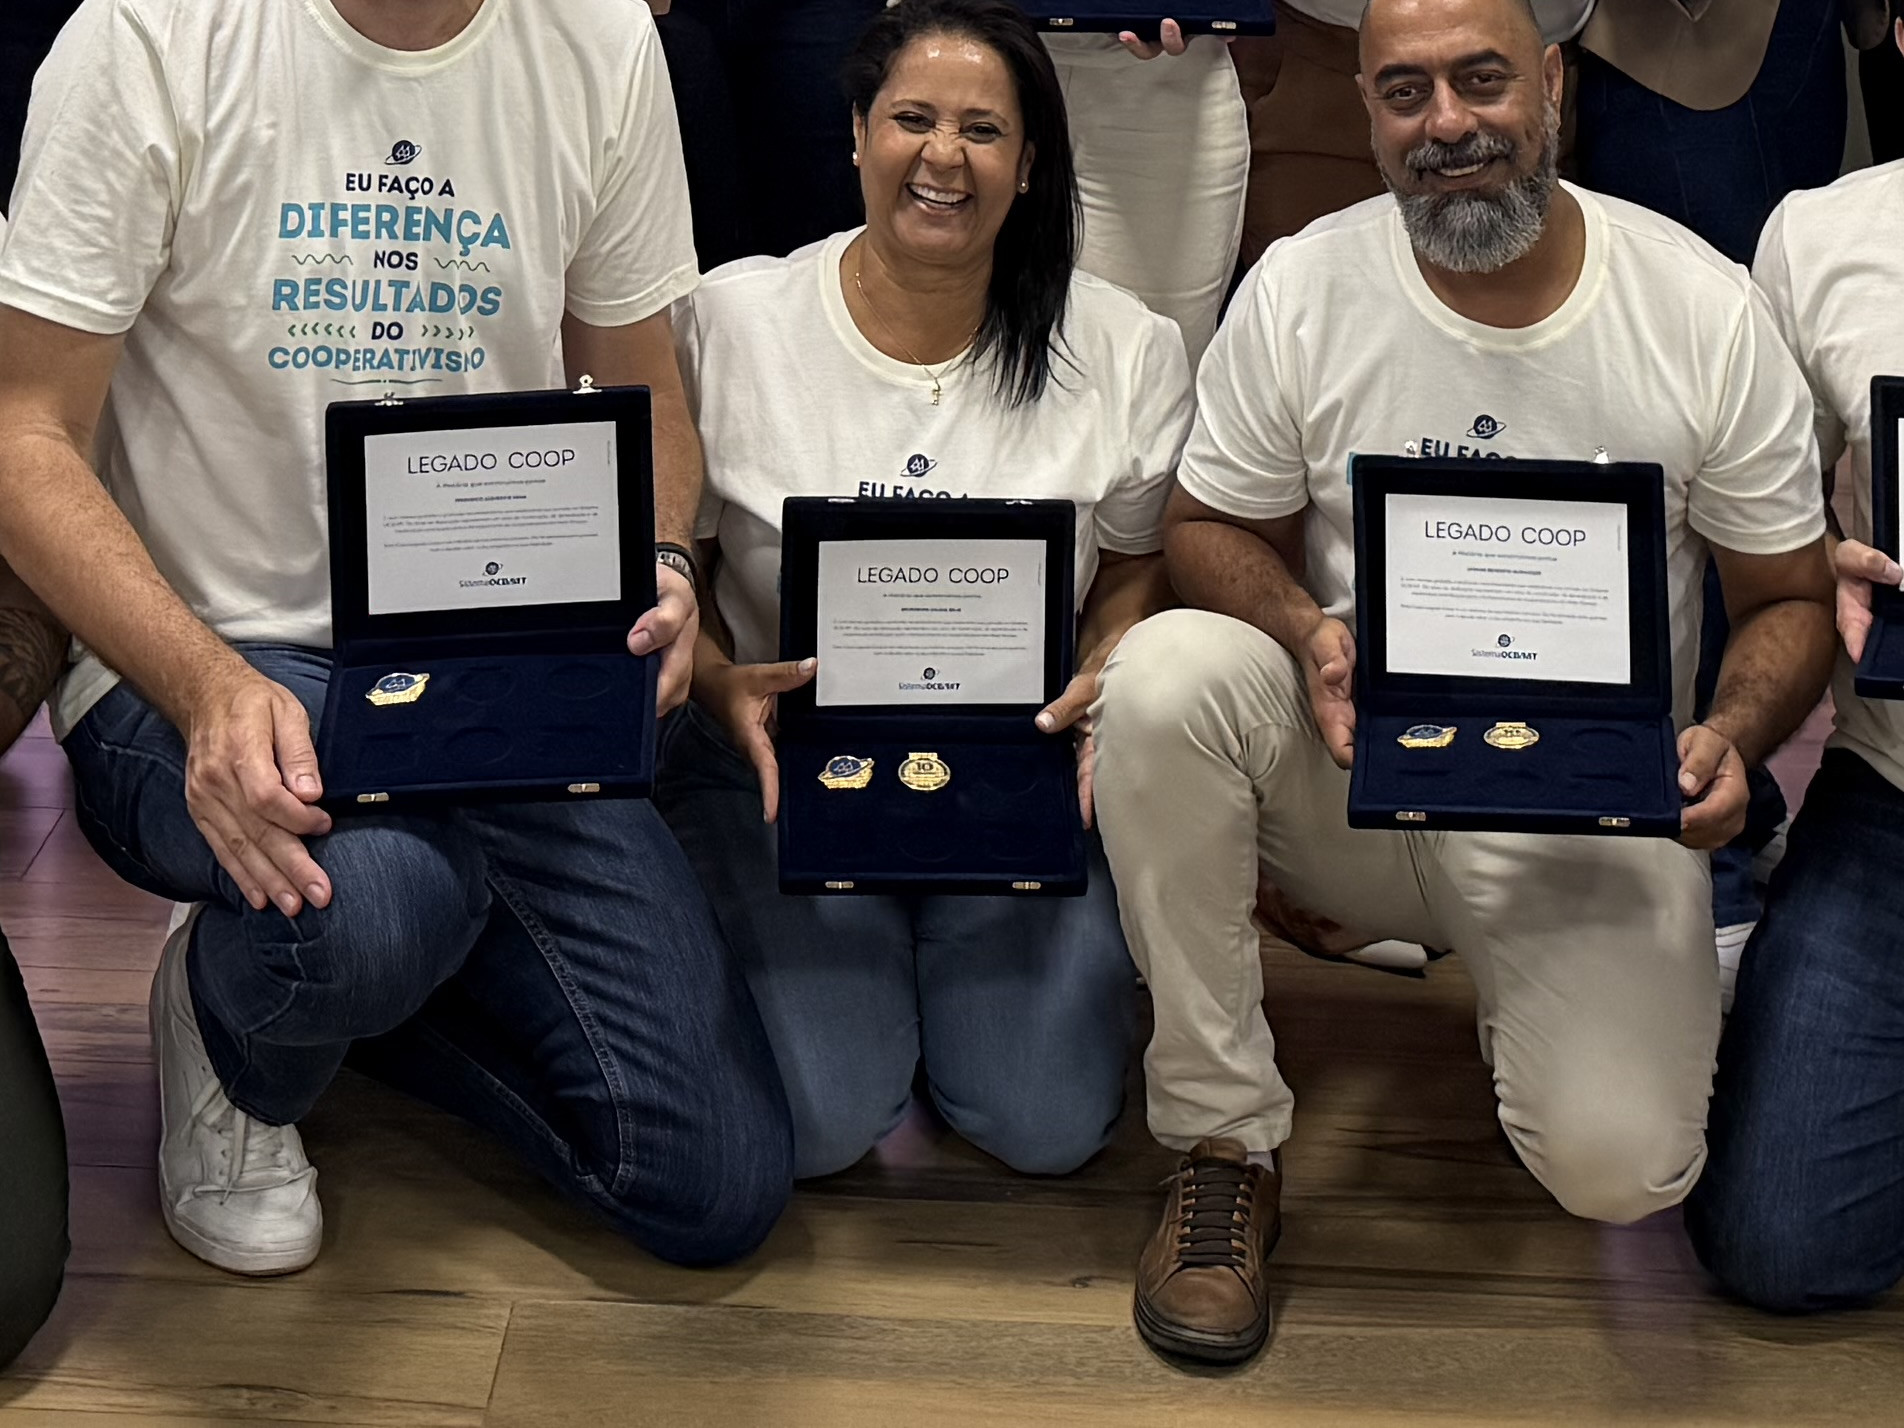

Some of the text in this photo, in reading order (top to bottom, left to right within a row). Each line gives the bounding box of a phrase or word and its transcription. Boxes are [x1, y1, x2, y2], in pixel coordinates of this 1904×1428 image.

[346, 173, 455, 200] EU FAÇO A
[278, 202, 511, 256] DIFERENÇA
[373, 250, 418, 271] NOS
[272, 277, 502, 316] RESULTADOS
[371, 321, 404, 340] DO
[408, 449, 575, 474] LEGADO COOP
[1426, 520, 1586, 546] LEGADO COOP
[858, 567, 1009, 584] LEGADO COOP
